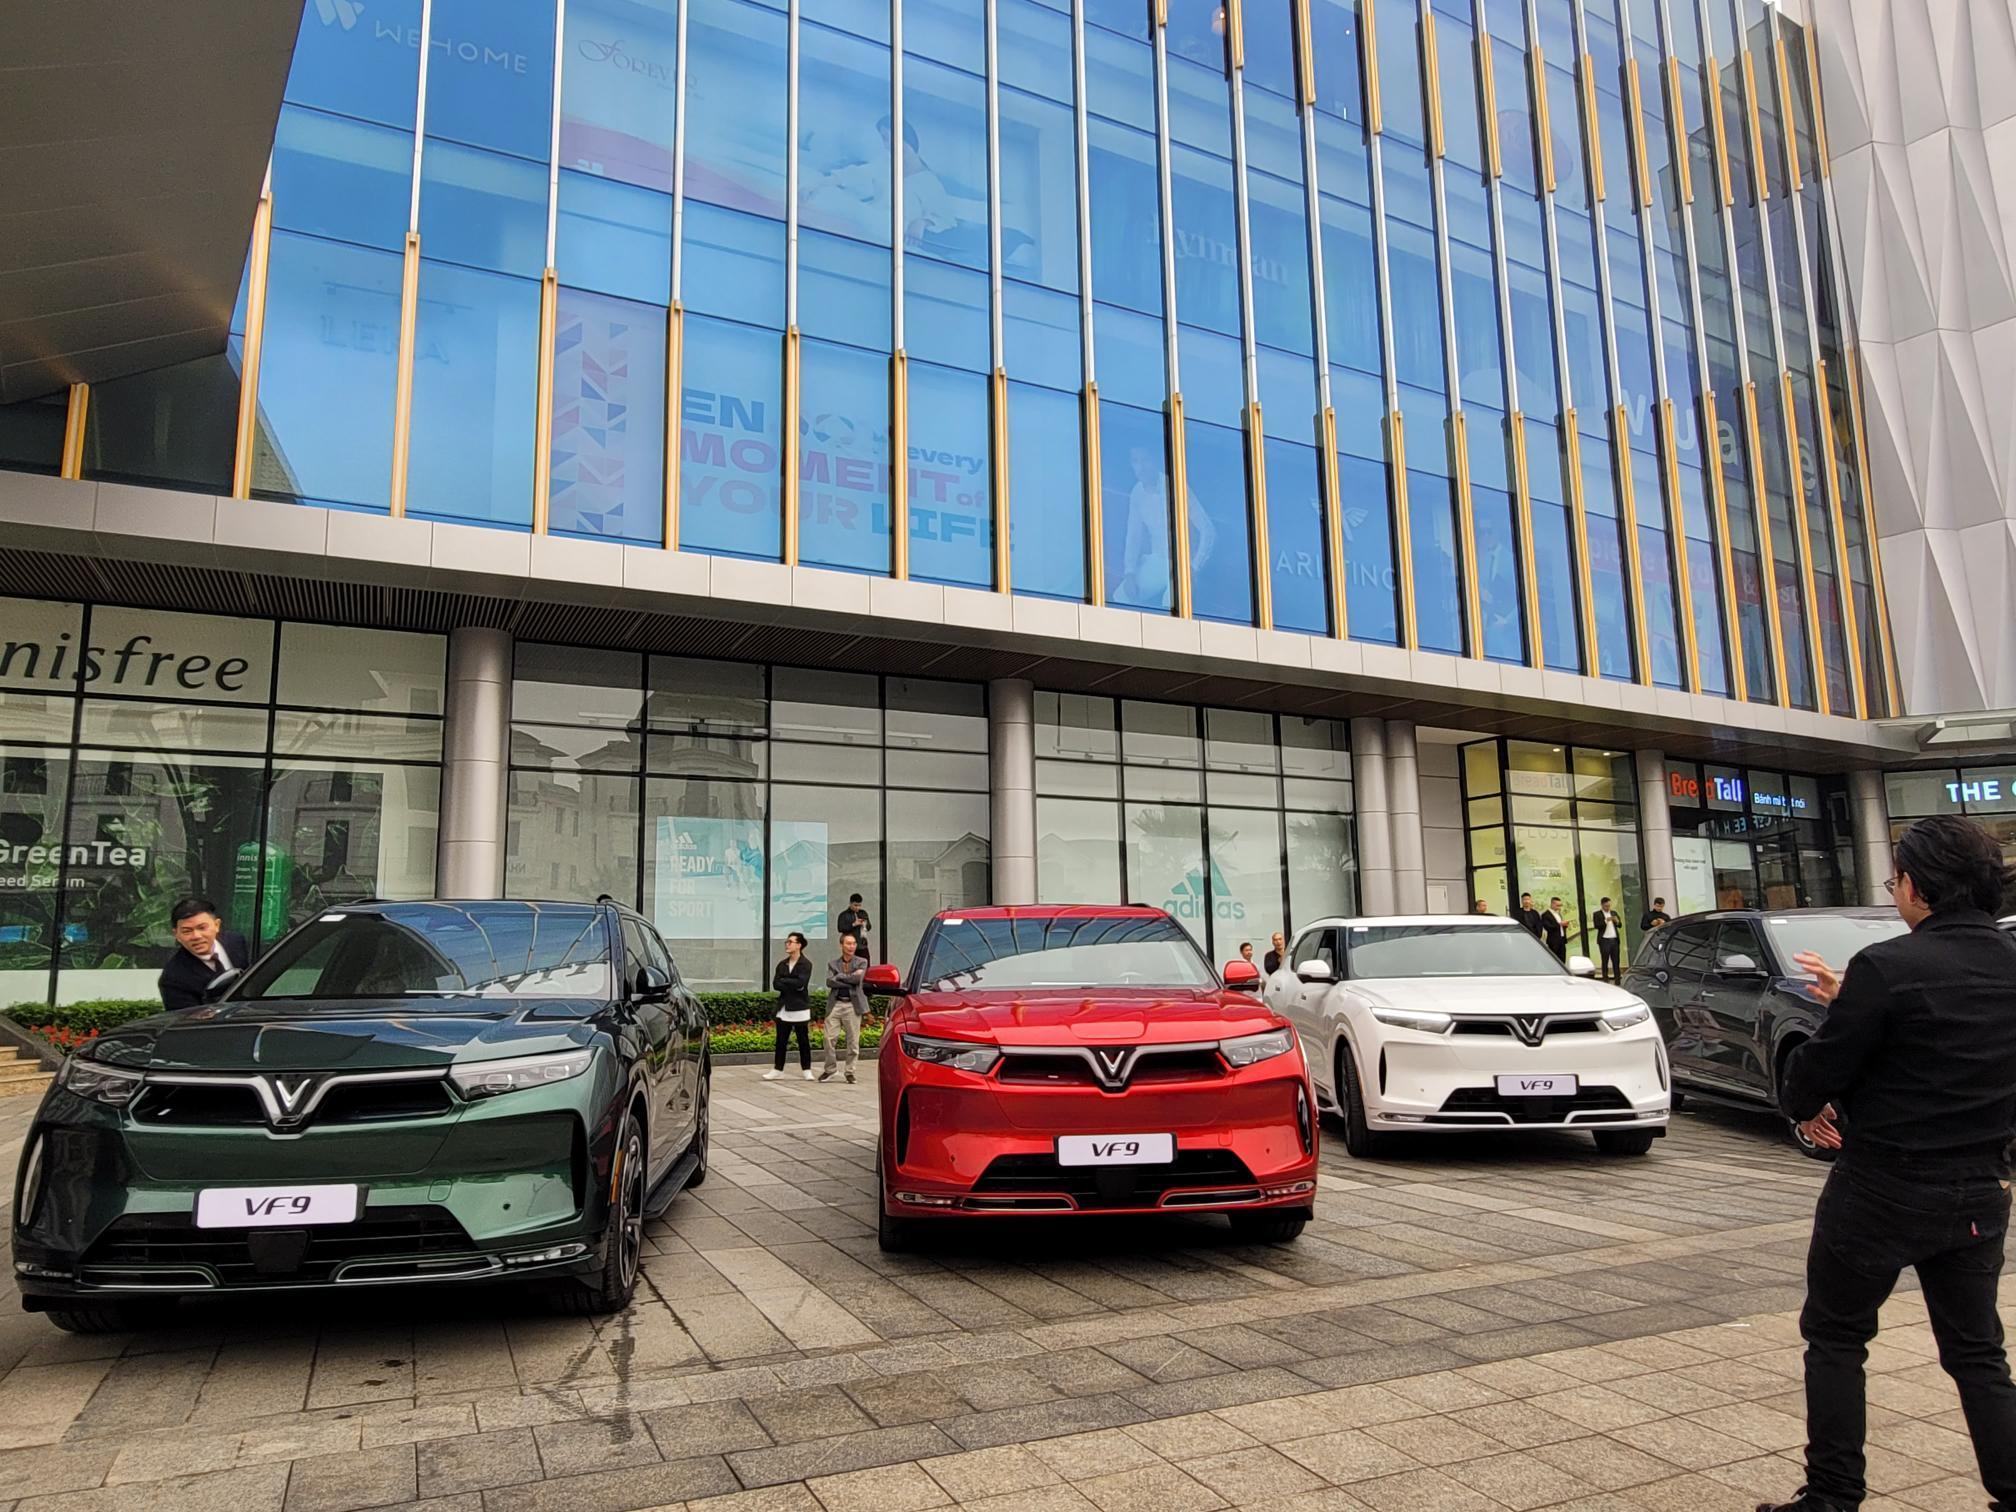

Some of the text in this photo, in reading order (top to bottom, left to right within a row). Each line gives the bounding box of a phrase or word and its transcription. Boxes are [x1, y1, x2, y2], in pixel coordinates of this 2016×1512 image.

[907, 445, 984, 475] every
[1945, 780, 2002, 803] THE
[670, 855, 715, 873] READY
[669, 900, 713, 919] SPORT
[1163, 894, 1246, 920] adias
[1520, 1080, 1554, 1091] VF9
[1091, 1141, 1140, 1157] VF9
[245, 1196, 312, 1216] VF9
